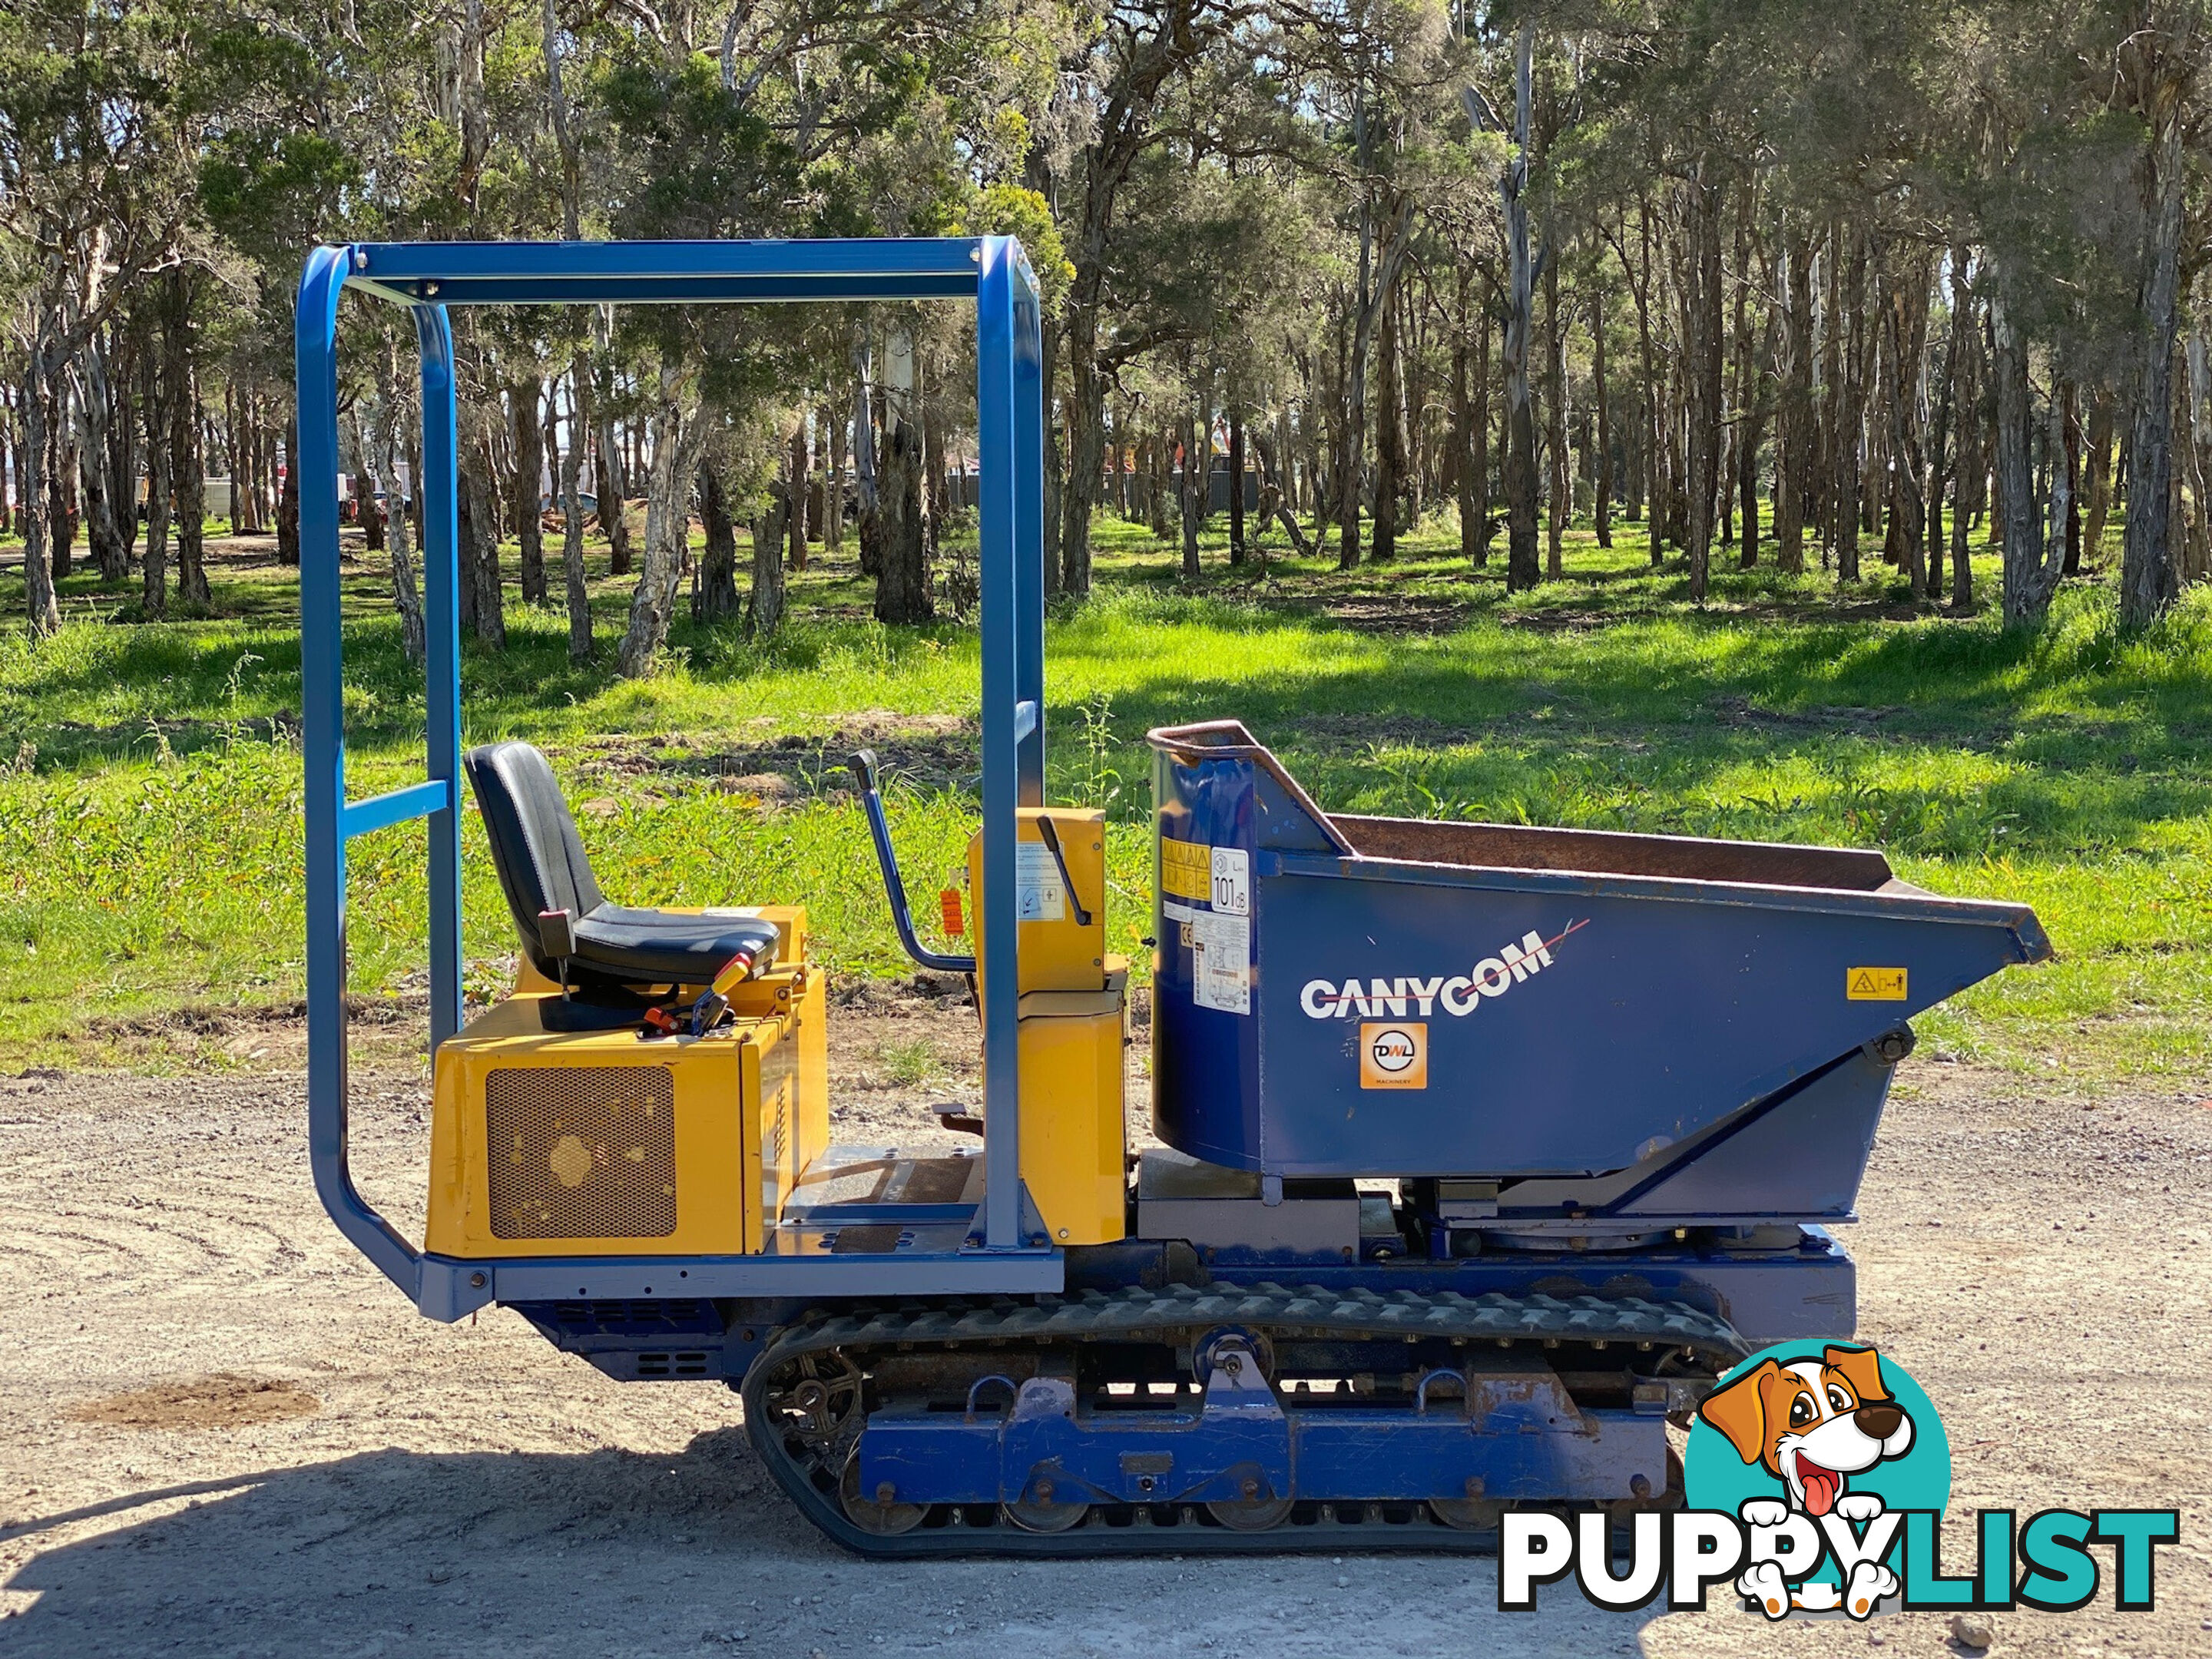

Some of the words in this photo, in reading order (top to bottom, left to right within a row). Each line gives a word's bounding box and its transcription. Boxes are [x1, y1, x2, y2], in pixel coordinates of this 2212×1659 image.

[1214, 876, 1234, 907] 101
[1235, 892, 1245, 909] dB
[1300, 929, 1554, 1019] CANYCOM
[1373, 1045, 1415, 1057] DWL
